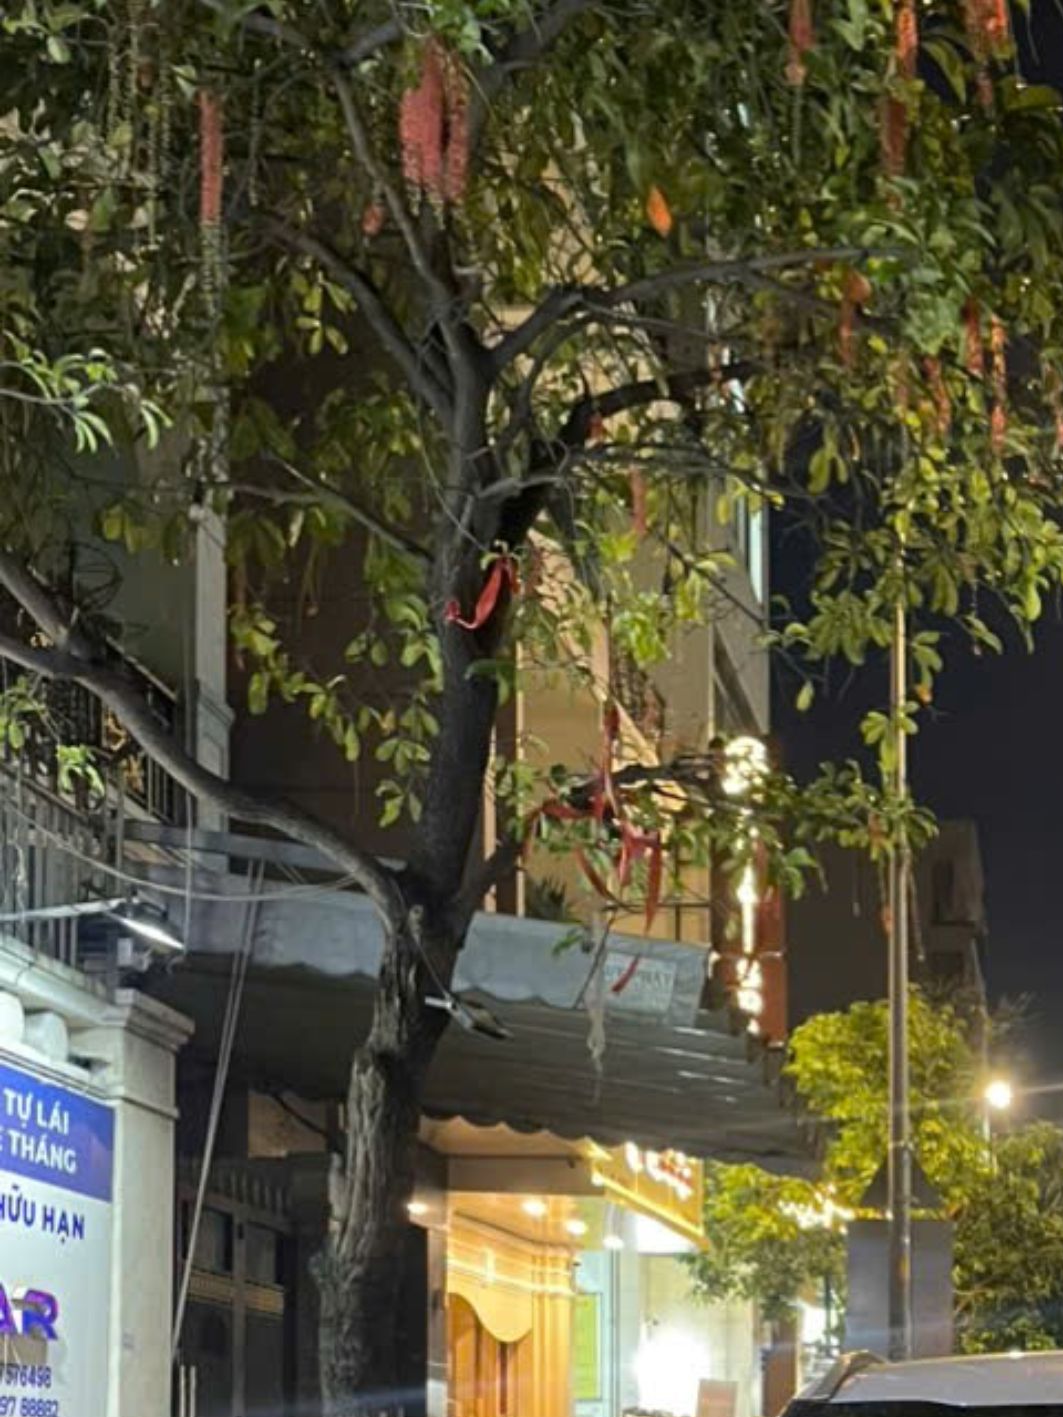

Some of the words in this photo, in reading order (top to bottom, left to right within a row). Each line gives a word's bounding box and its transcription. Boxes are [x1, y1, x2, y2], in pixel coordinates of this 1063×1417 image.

[3, 1087, 33, 1129] TỰ
[37, 1100, 69, 1135] LÁI
[7, 1129, 76, 1174] THÁNG
[42, 1203, 85, 1246] HẠN
